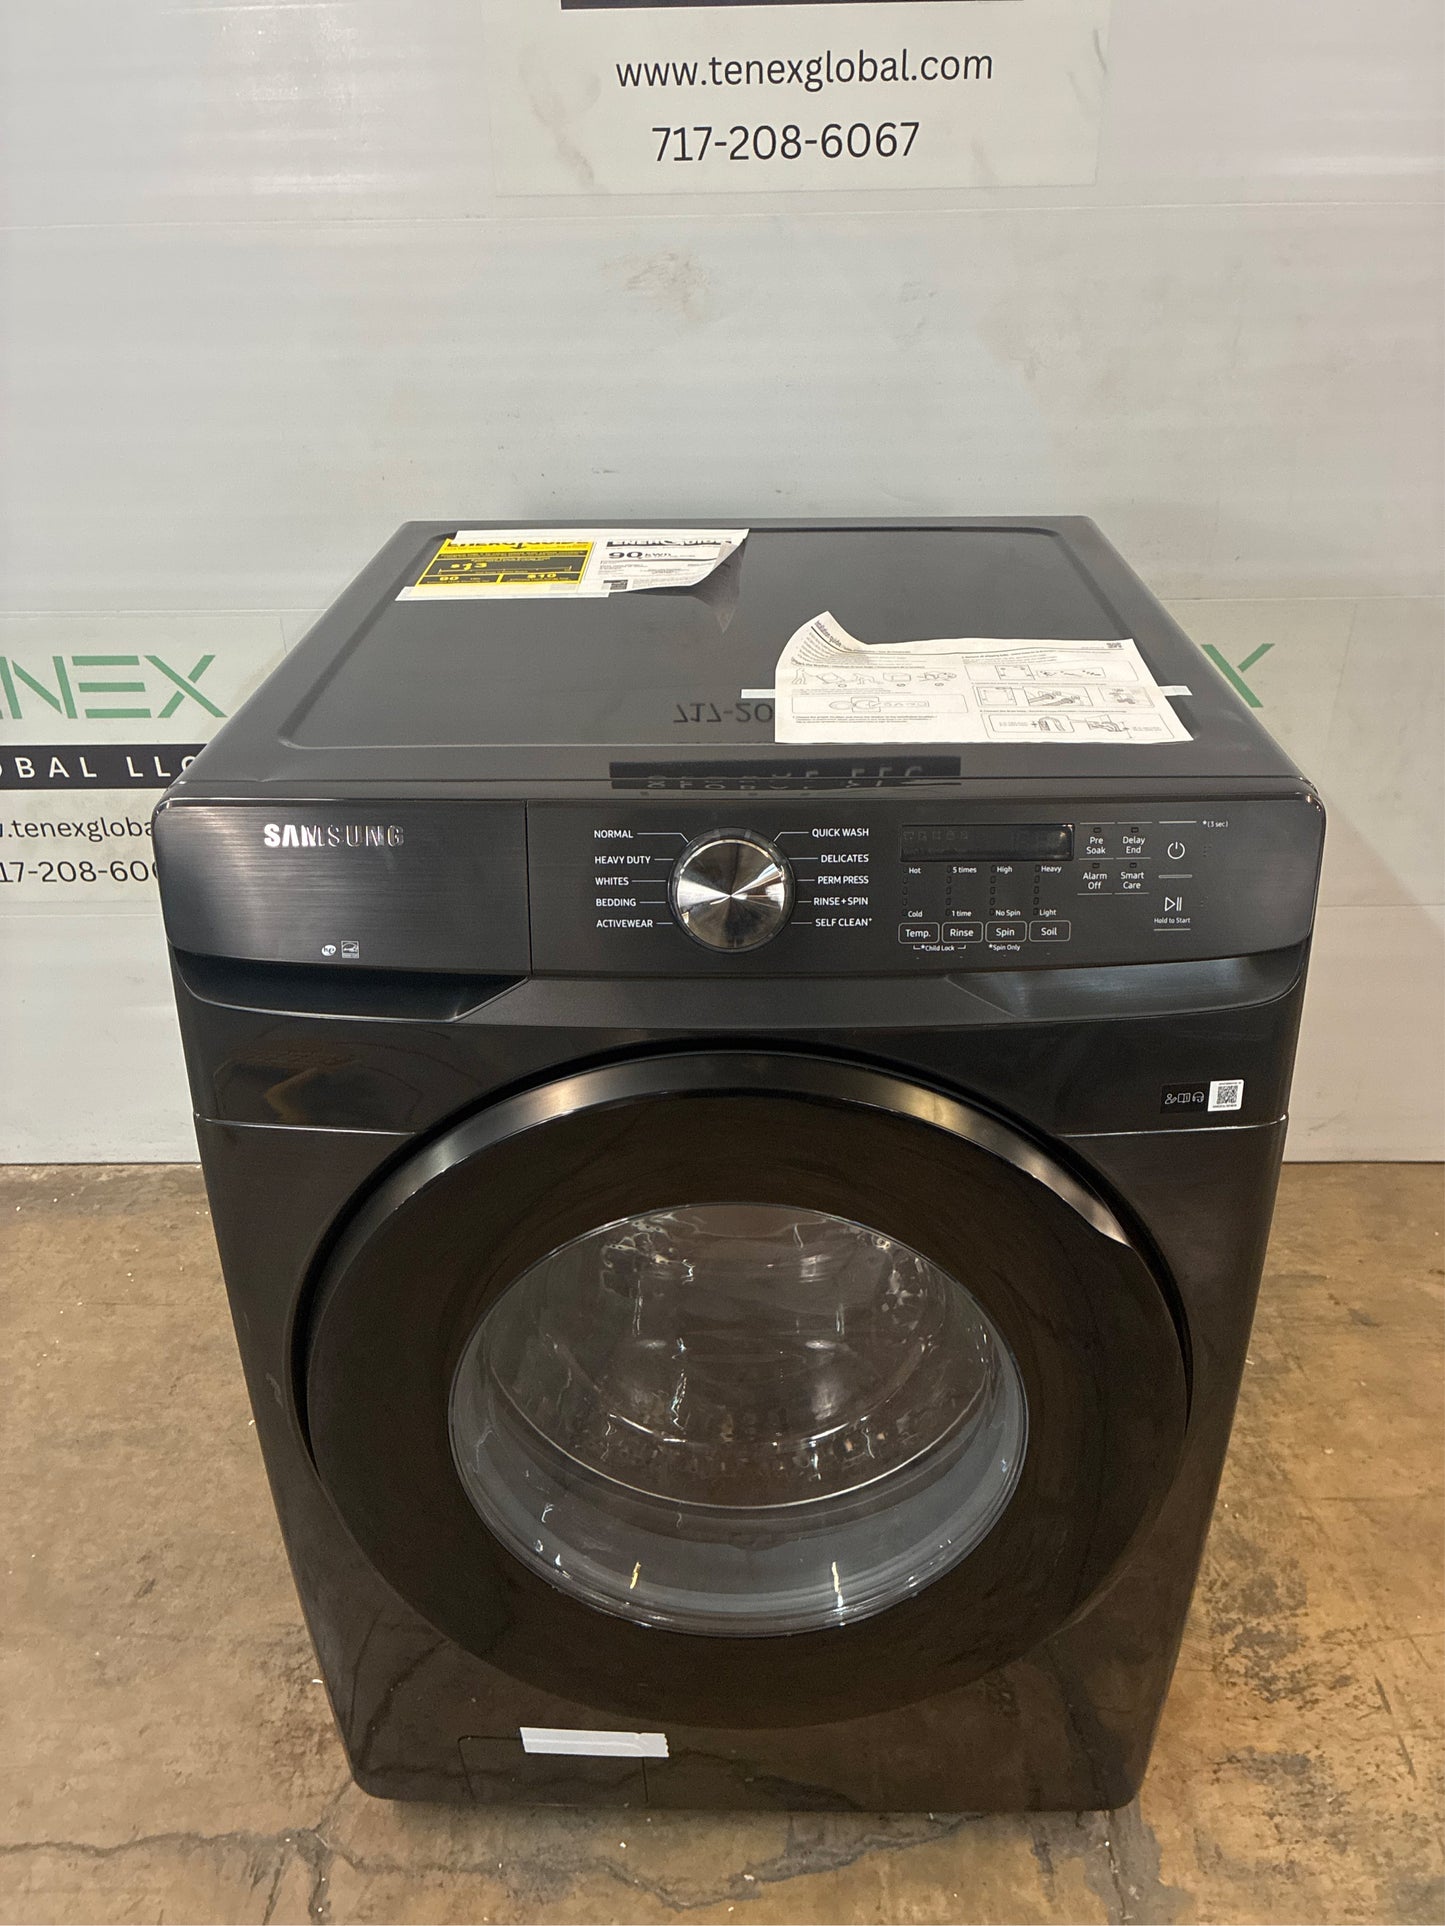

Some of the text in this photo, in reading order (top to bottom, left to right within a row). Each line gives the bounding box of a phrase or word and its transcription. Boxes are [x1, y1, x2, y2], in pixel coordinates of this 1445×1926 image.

[616, 49, 993, 92] www.tenexglobal.com
[652, 122, 920, 162] 717-208-6067
[0, 655, 227, 719] NEX
[0, 756, 98, 778] BAL
[264, 824, 403, 847] SAMSUNG
[594, 830, 633, 839] NORMAL
[812, 828, 869, 837] QUICK WASH
[1123, 836, 1145, 845] Delay
[595, 856, 651, 865] HEAVY DUTY
[821, 854, 869, 863] DELICATES
[0, 861, 158, 883] 17-208-60
[997, 866, 1012, 874] High
[818, 876, 868, 884] PERM PRESS
[1083, 872, 1107, 880] Alarm
[596, 877, 629, 885] WHITES
[596, 899, 636, 907] BEDDING
[1007, 910, 1020, 918] Spin
[1040, 909, 1056, 917] Light
[597, 920, 653, 928] ACTIVEWEAR
[816, 918, 836, 926] SELF
[905, 929, 931, 938] Temp.
[950, 928, 974, 937] Rinse
[996, 928, 1015, 937] Spin
[1041, 927, 1057, 935] Soil
